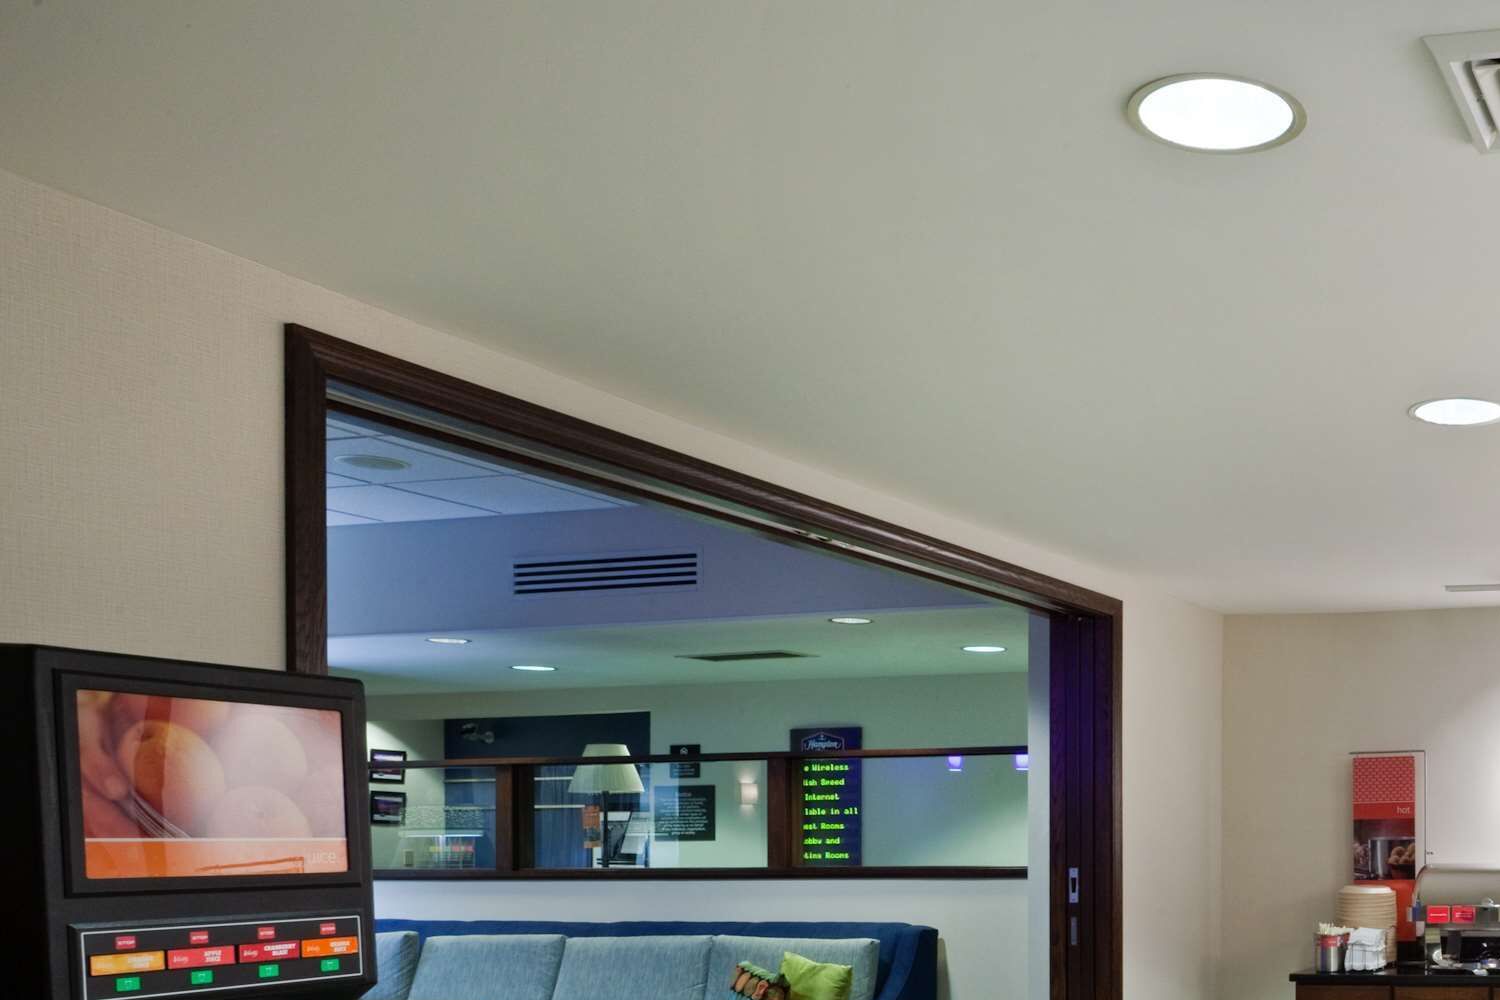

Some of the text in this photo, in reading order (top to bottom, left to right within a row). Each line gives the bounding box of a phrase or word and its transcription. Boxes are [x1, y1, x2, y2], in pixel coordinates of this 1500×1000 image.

[804, 738, 841, 750] Hampton
[811, 763, 849, 771] Wireless
[804, 793, 840, 801] Internet
[830, 807, 840, 815] in
[843, 806, 858, 815] all
[820, 821, 845, 830] Rooms
[825, 836, 841, 845] and
[825, 851, 849, 860] Rooms
